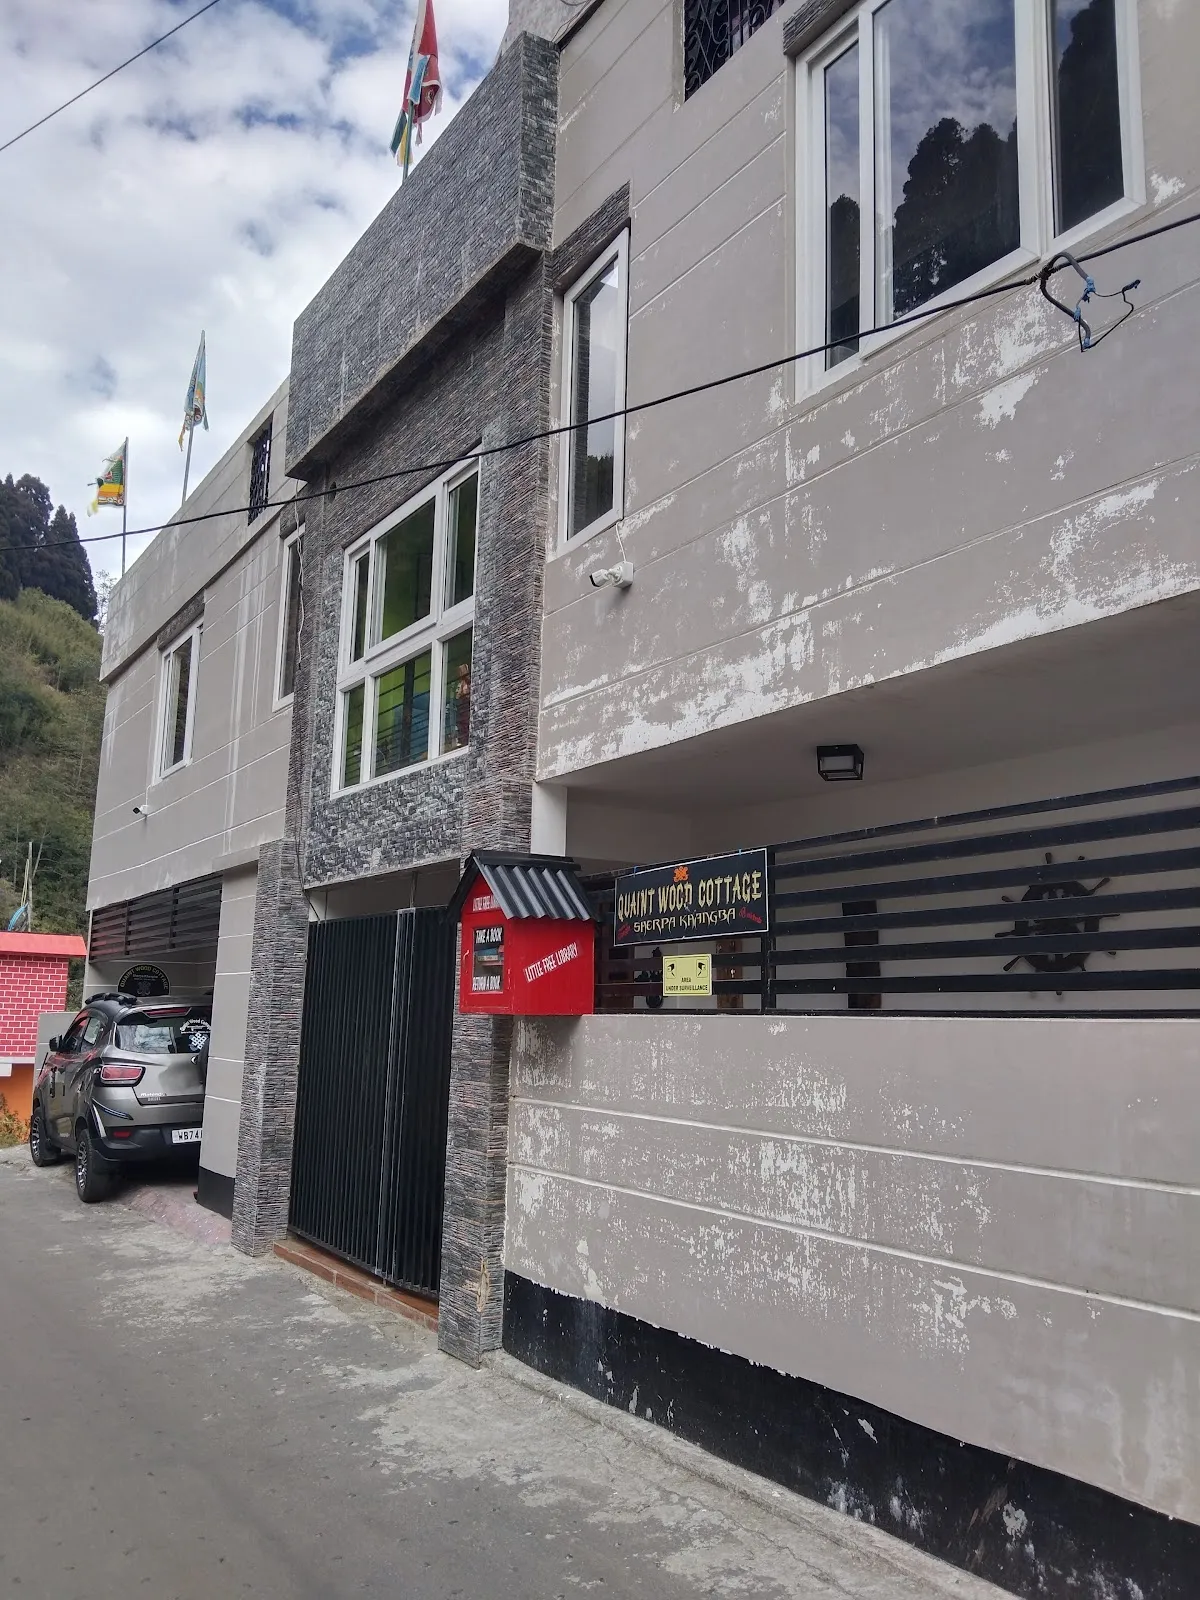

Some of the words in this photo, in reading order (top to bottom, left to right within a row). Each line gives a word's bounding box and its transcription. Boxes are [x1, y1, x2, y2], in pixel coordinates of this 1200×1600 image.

[618, 888, 655, 922] QUAINT
[658, 882, 693, 914] WOOD
[698, 870, 762, 908] COTTAGE
[476, 929, 486, 943] TAKE
[490, 927, 502, 942] BOOK
[633, 916, 676, 936] SHERPA
[525, 961, 544, 983] LITTLE
[542, 953, 557, 974] FREE
[555, 942, 578, 966] LIBRARY
[120, 969, 135, 988] QUAINT
[152, 967, 169, 990] COTTAGE
[472, 977, 486, 992] RETURN
[177, 1129, 203, 1141] WB74
